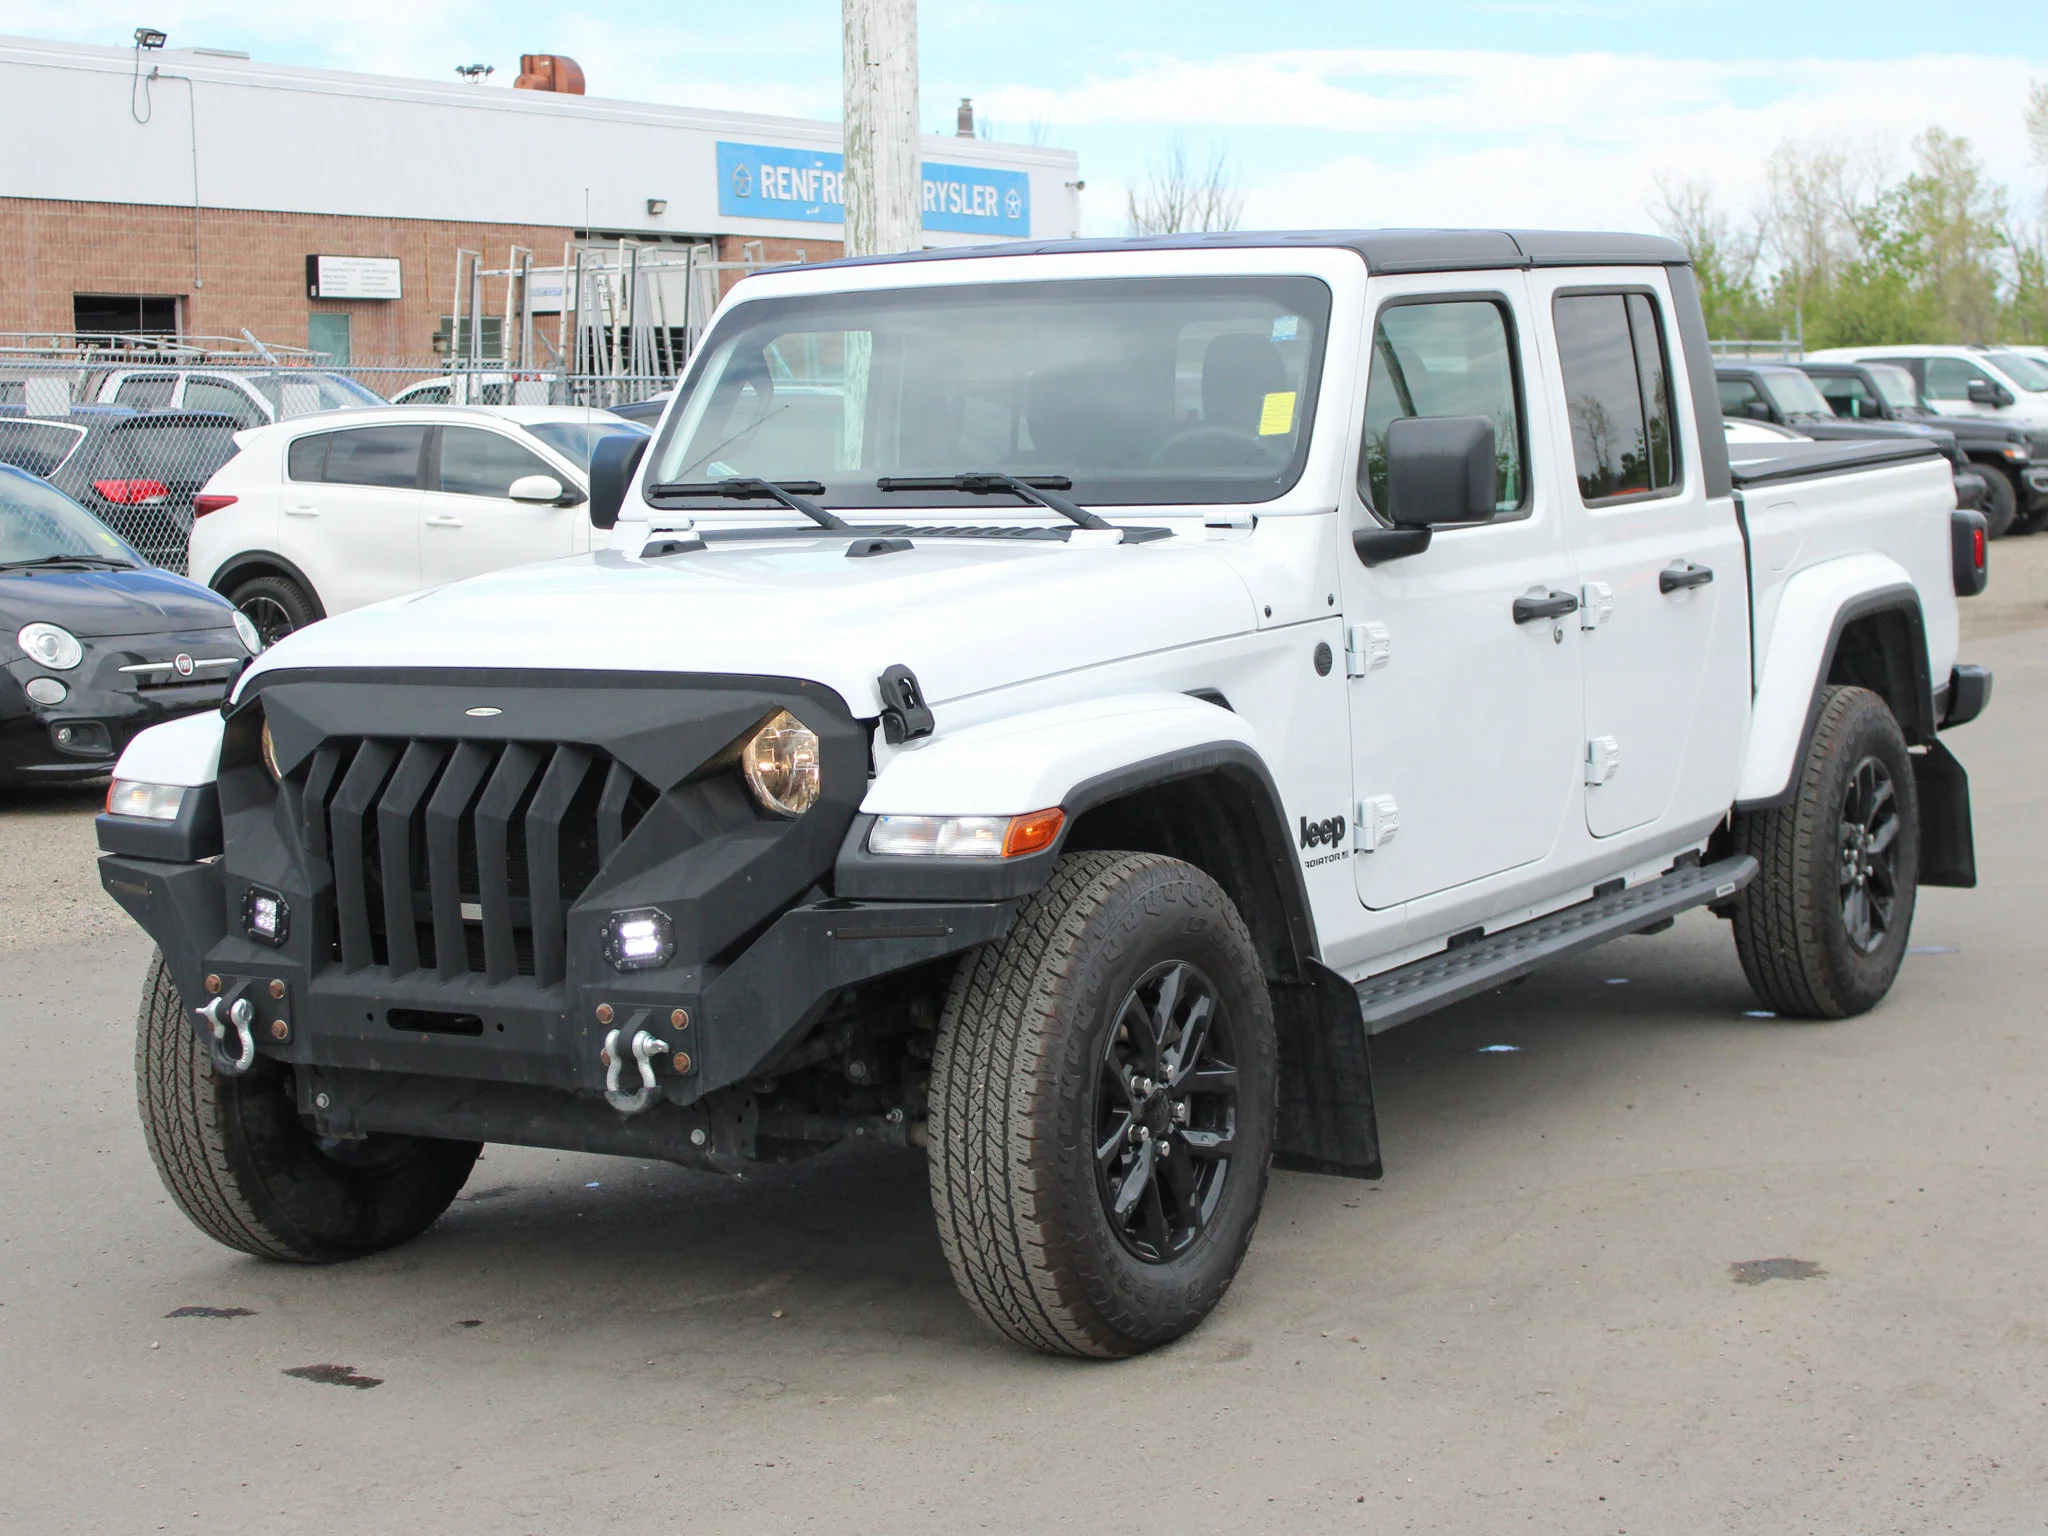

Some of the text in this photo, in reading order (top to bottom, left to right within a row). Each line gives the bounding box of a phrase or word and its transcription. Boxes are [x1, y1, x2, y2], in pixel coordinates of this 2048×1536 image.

[922, 180, 999, 217] RYSLER
[1300, 815, 1346, 850] Jeep
[1304, 852, 1341, 869] ADIATOR
